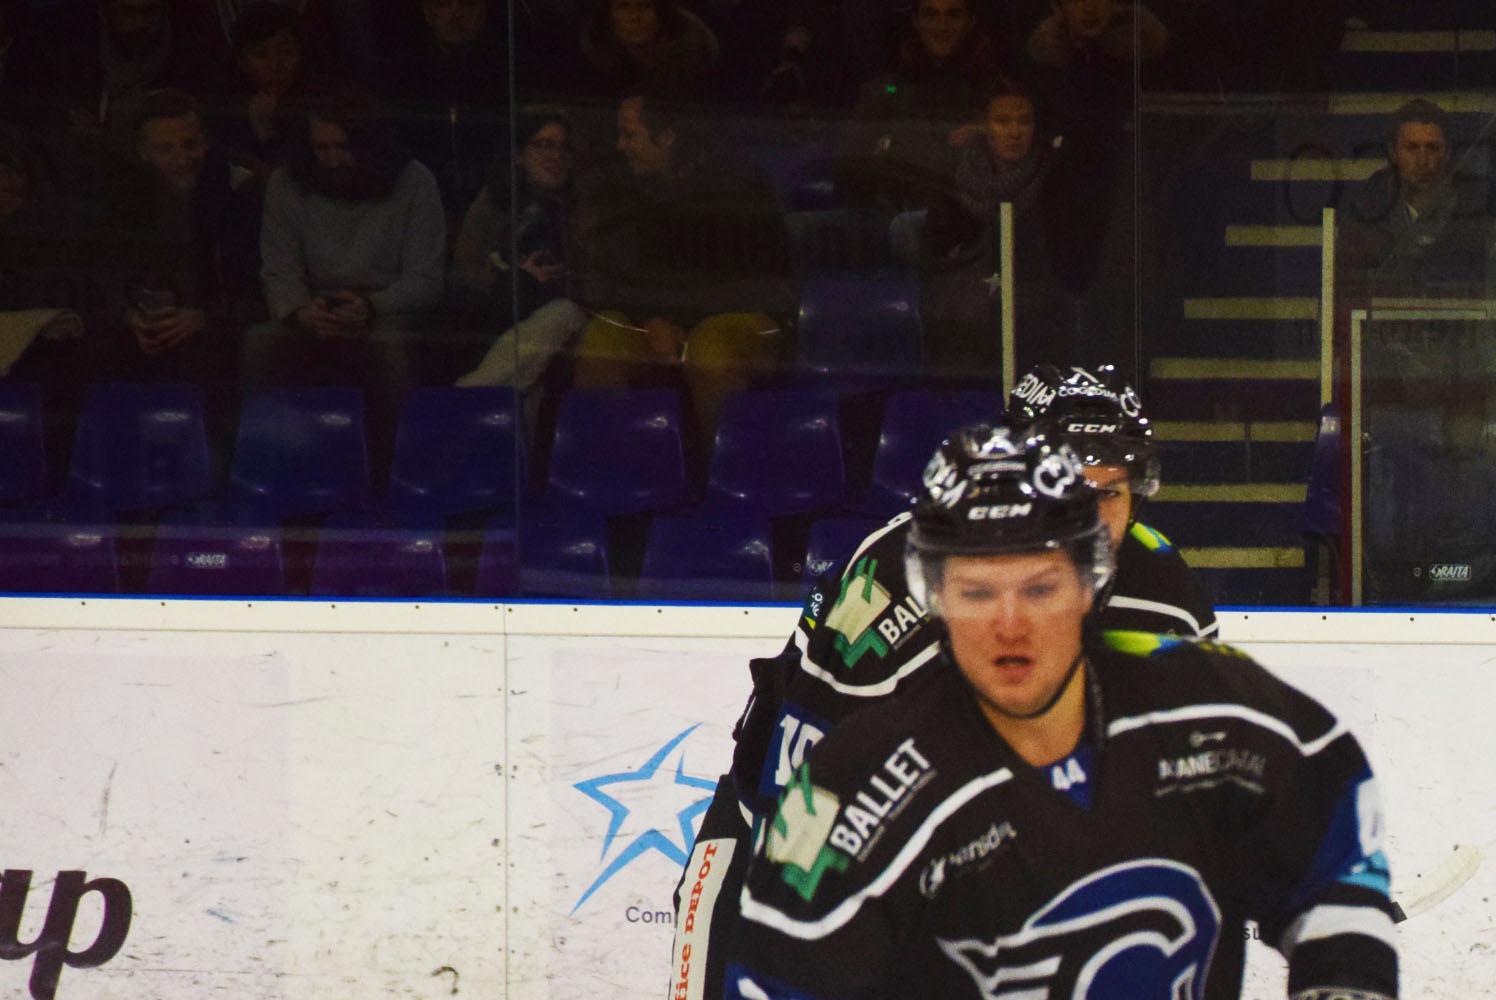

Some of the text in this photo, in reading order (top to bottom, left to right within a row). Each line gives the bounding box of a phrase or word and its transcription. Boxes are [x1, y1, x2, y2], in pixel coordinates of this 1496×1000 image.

[1067, 423, 1117, 434] CCM
[967, 502, 1033, 521] CCM
[878, 596, 929, 646] BAL
[1052, 758, 1086, 789] 44
[829, 737, 931, 856] BALLET
[685, 842, 718, 933] DEPOT
